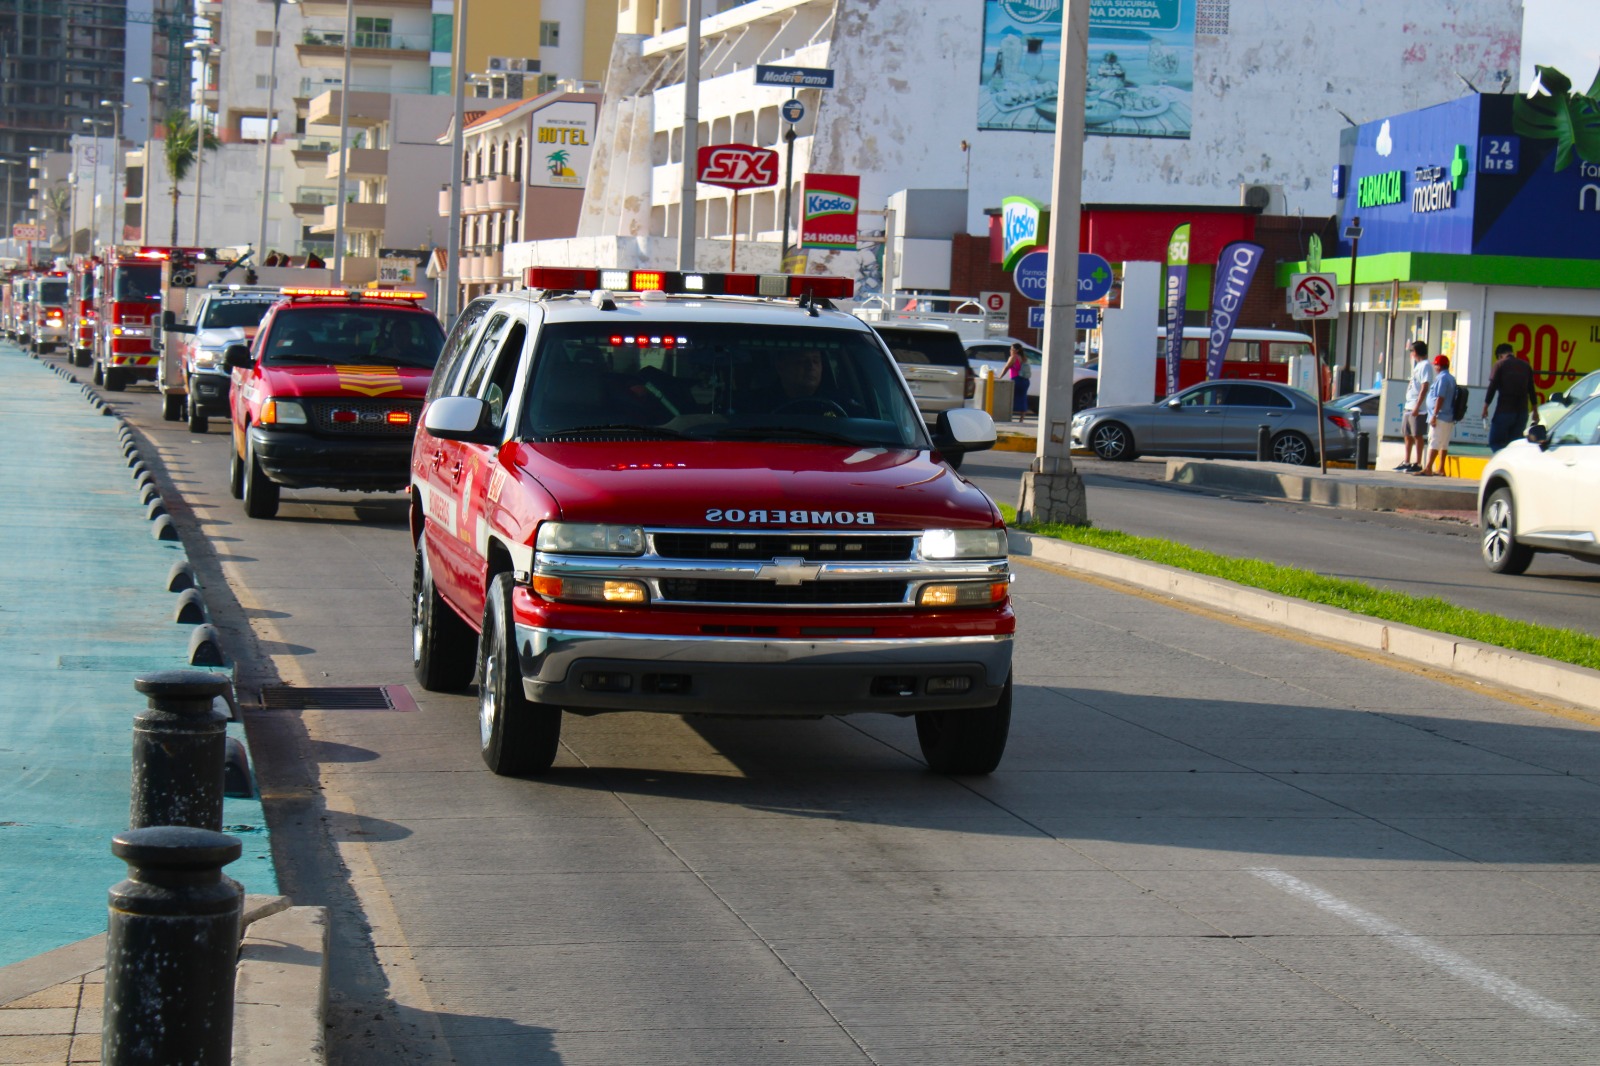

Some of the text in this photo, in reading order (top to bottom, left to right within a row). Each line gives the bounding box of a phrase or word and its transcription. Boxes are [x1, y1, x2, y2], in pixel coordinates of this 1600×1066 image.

[1089, 8, 1161, 19] NA DORADA
[537, 127, 589, 146] HOTEL
[1490, 140, 1511, 155] 24
[1485, 155, 1514, 170] hrs
[1357, 170, 1402, 209] FARMACIA
[808, 196, 851, 214] Kiosko
[1005, 207, 1035, 252] Kiosko
[803, 232, 856, 243] 24 HORAS
[1021, 277, 1093, 291] mona
[1033, 313, 1093, 323] FACIA
